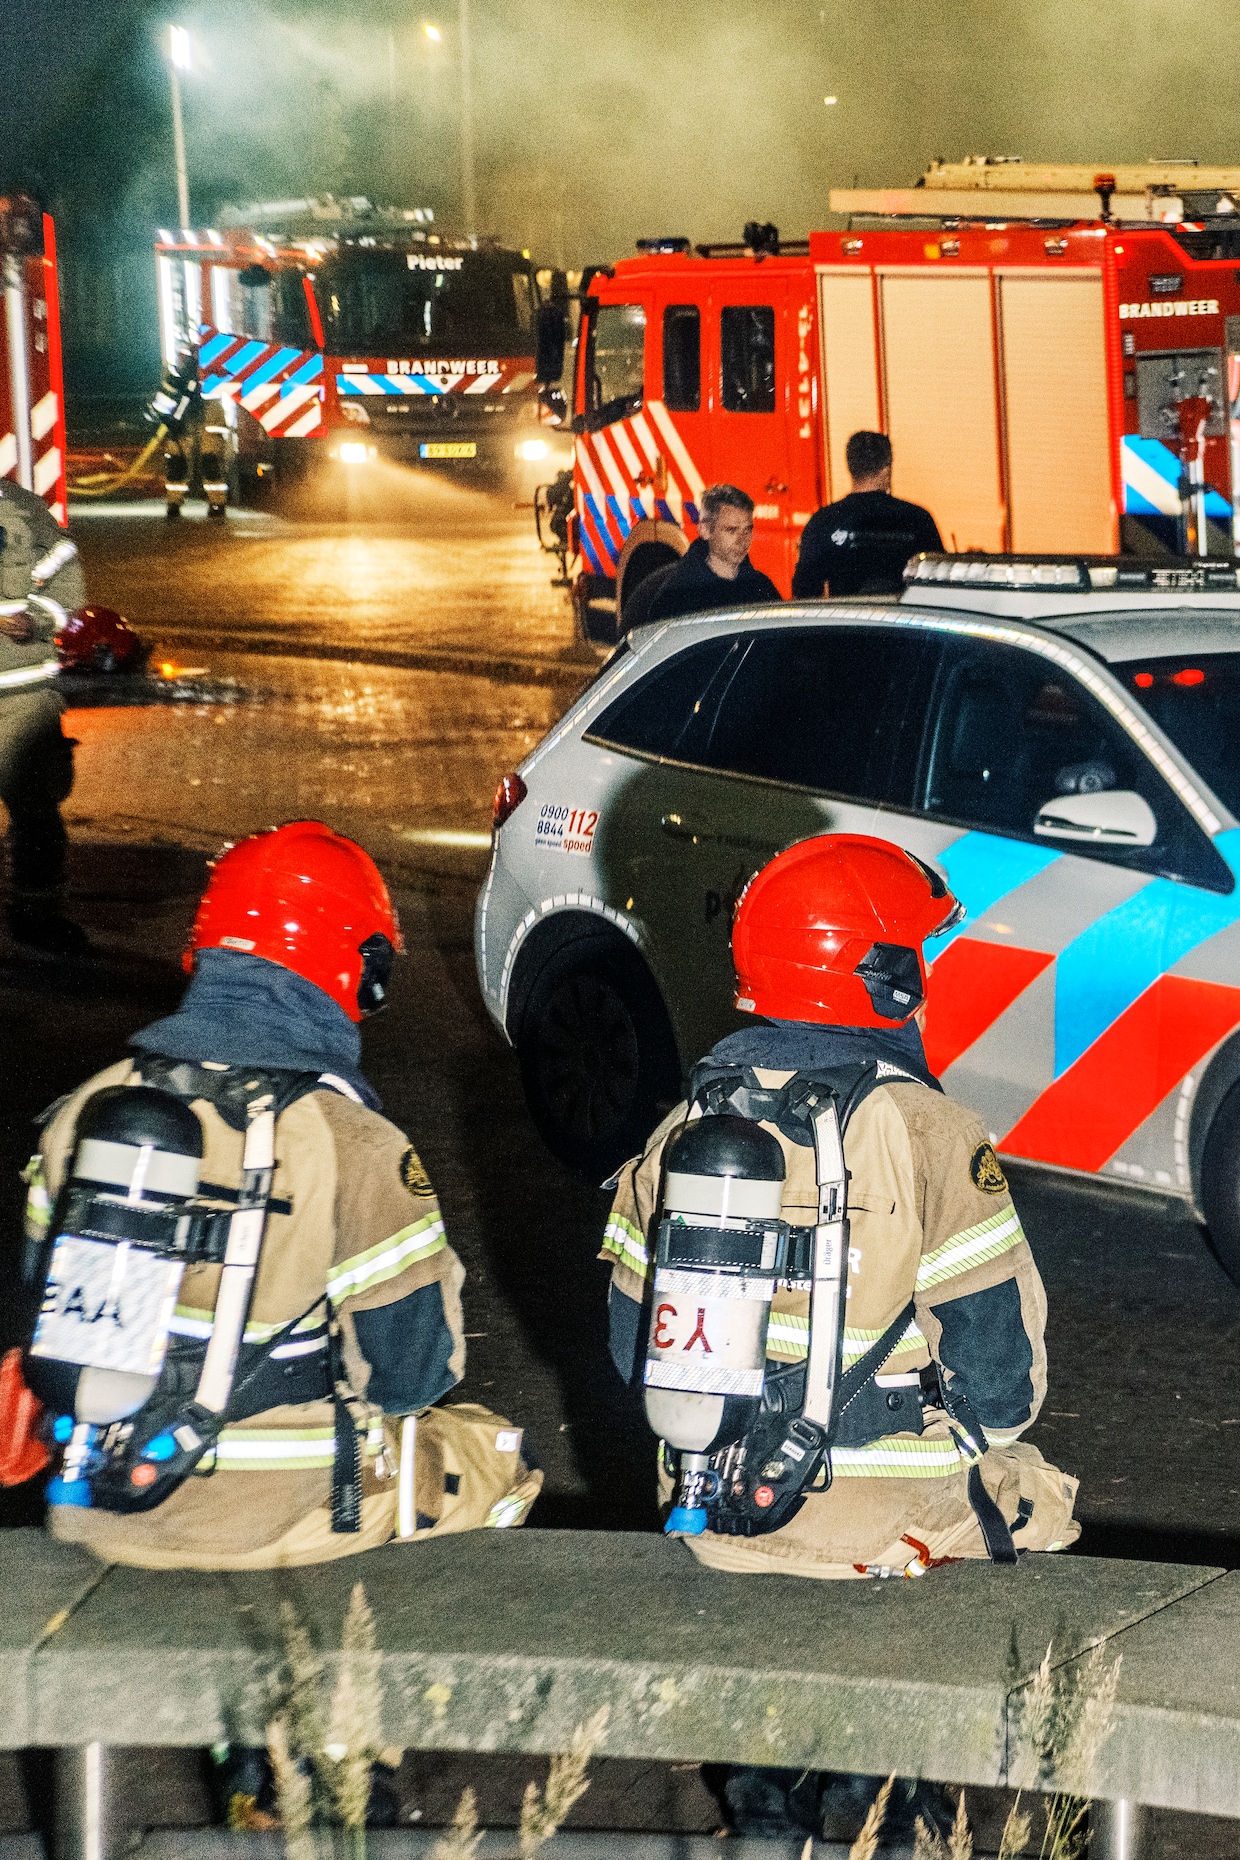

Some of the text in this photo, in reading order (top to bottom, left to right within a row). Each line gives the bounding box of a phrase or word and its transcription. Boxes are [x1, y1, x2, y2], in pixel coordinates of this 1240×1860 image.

[406, 254, 464, 270] Pieter
[1118, 299, 1220, 319] BRANDWEER
[386, 359, 500, 375] BRANDWEER
[540, 804, 569, 821] 0900
[536, 820, 564, 837] 8844
[568, 809, 598, 837] 112
[563, 838, 592, 853] spoed
